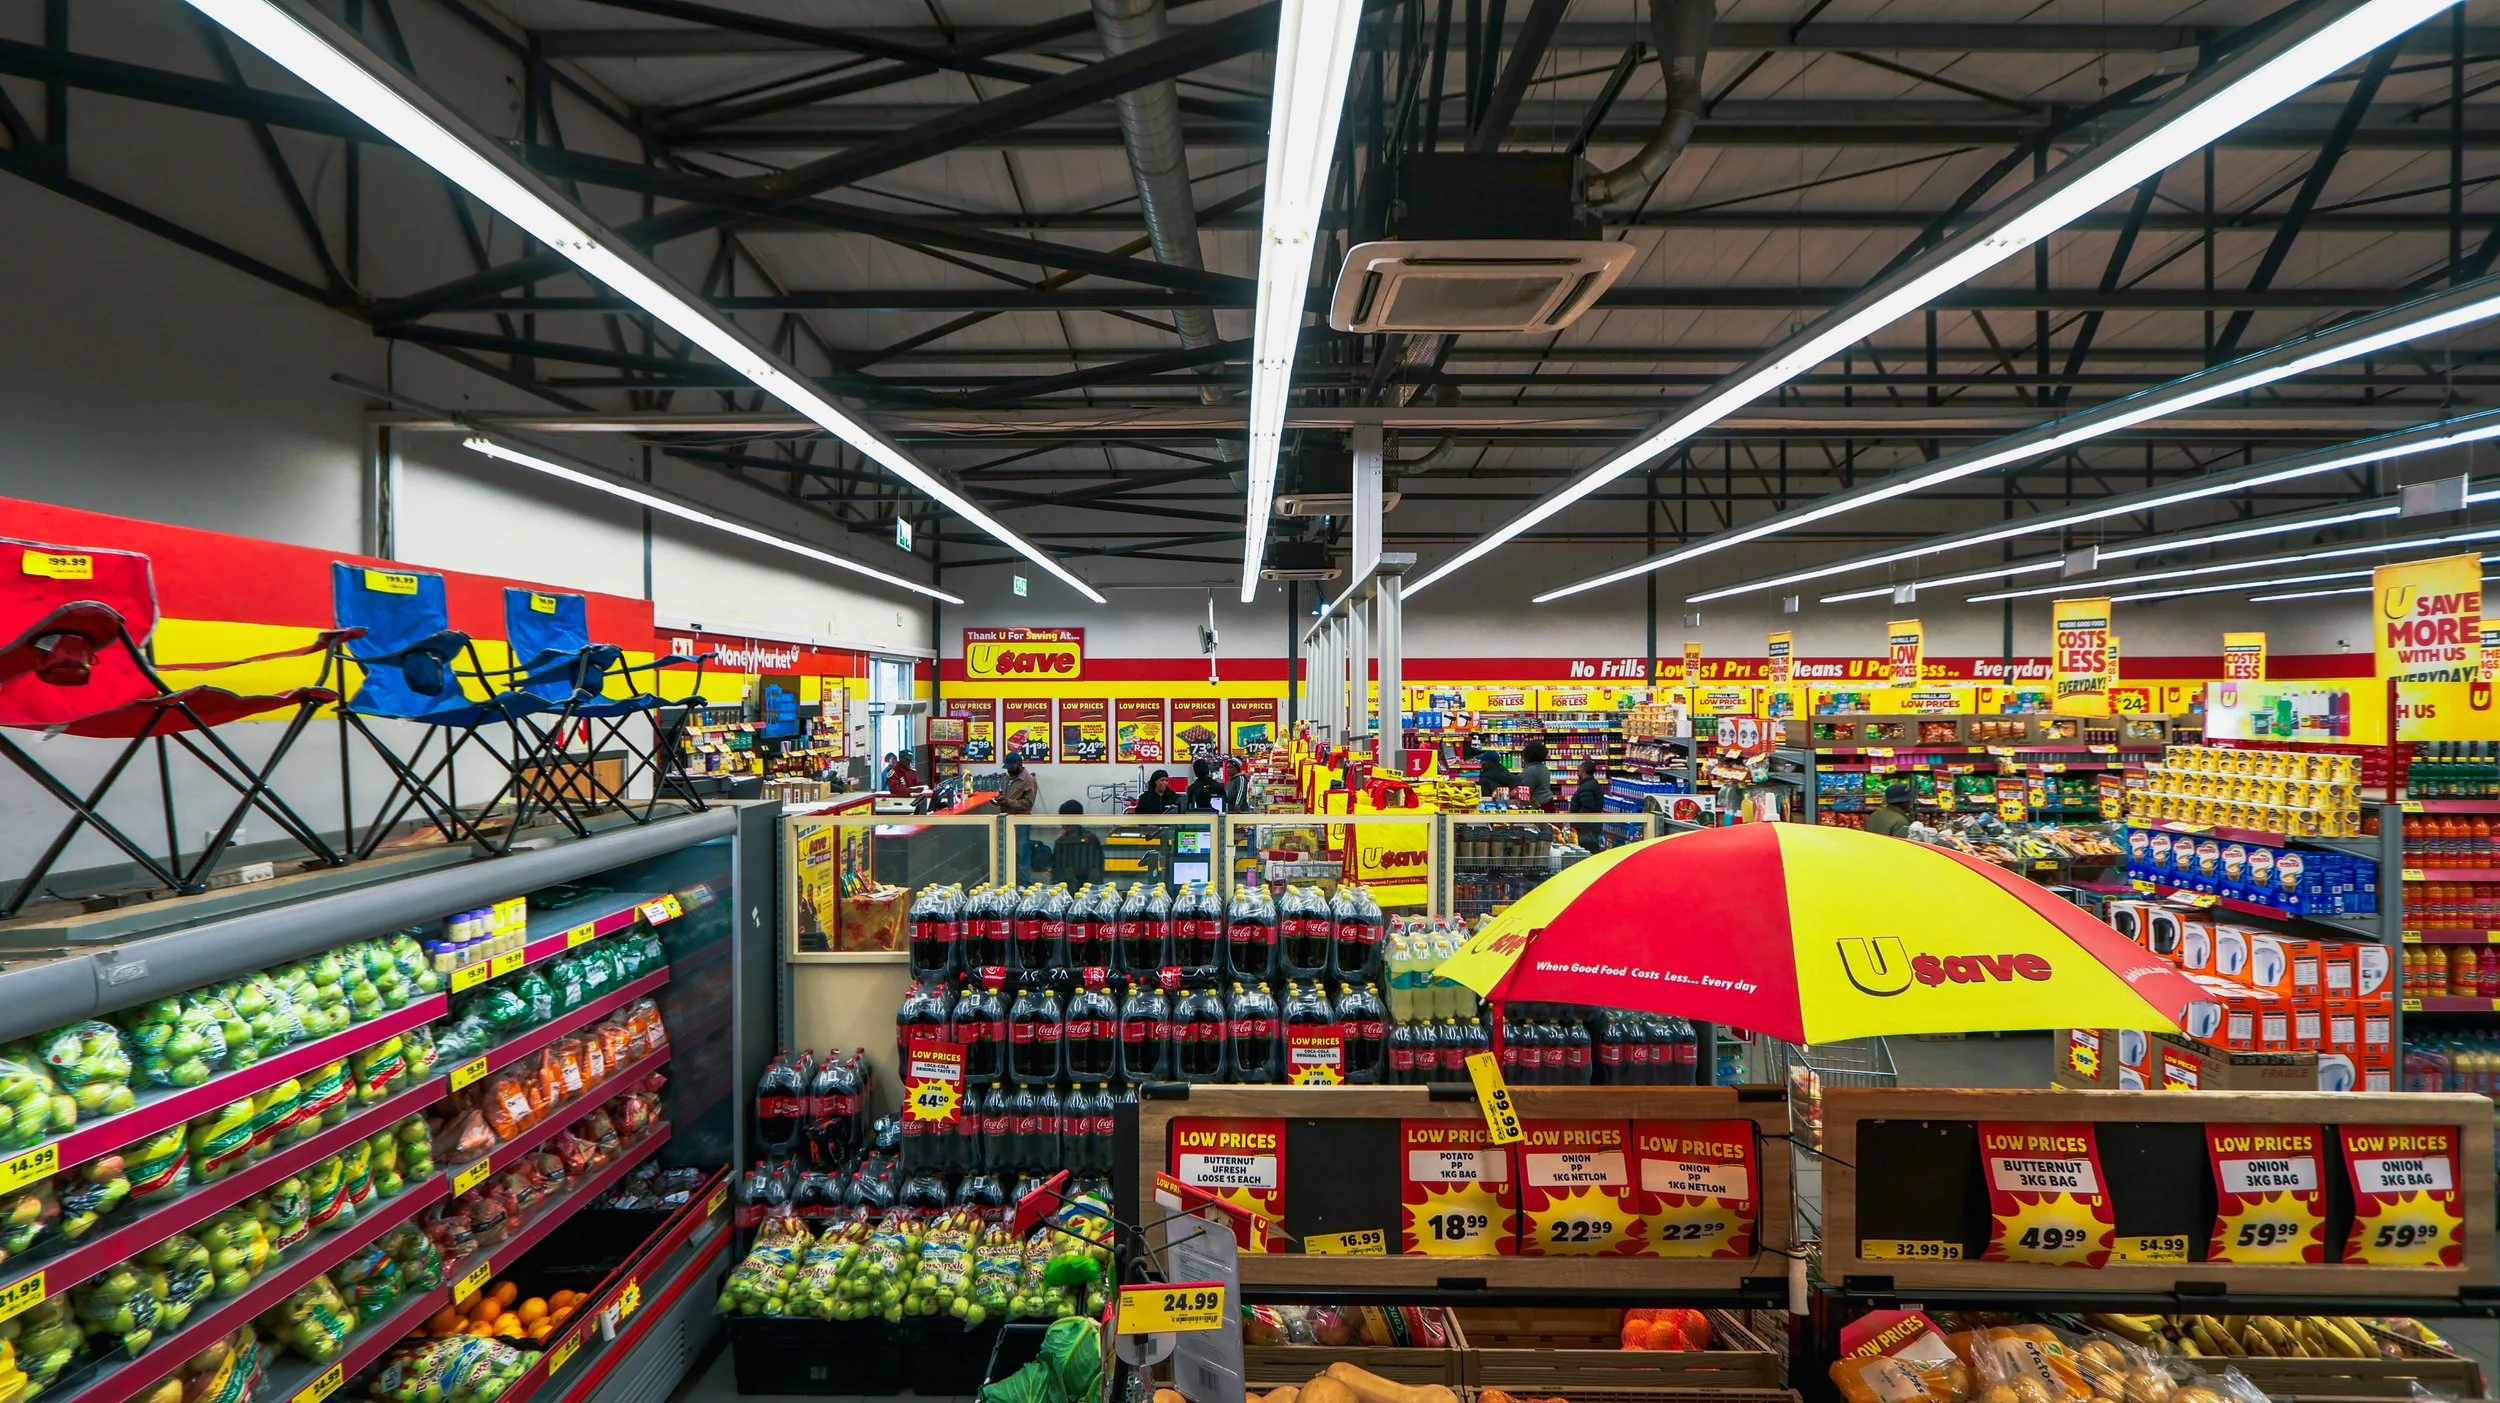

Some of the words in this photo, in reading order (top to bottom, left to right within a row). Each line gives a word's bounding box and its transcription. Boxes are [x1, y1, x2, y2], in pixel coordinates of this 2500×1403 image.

[2384, 584, 2416, 620] U
[2416, 591, 2480, 617] SAVE
[967, 631, 997, 640] Thank
[999, 632, 1006, 640] U
[1008, 632, 1025, 640] For
[1026, 631, 1058, 642] Saving
[1060, 632, 1080, 640] At...
[2387, 615, 2481, 648] MORE
[2058, 630, 2107, 649] COSTS
[1890, 646, 1918, 664] LOW
[2058, 650, 2106, 673] LESS
[2225, 653, 2261, 664] COSTS
[2398, 649, 2440, 664] WITH
[2444, 647, 2466, 661] US
[1570, 660, 1595, 678] No
[1600, 659, 1645, 678] Frills
[1655, 660, 1718, 678] Lowst
[1849, 660, 1862, 677] U
[1890, 665, 1918, 678] PRICES
[2226, 665, 2260, 680] LESS
[2058, 677, 2107, 694] EVERYDAY!
[1119, 702, 1135, 710] LOW
[1136, 702, 1160, 710] PRICES
[1174, 702, 1190, 710] LOW
[1191, 702, 1216, 710] PRICES
[1232, 702, 1247, 710] LOW
[1248, 702, 1273, 710] PRICES
[1506, 698, 1524, 706] LESS
[1569, 698, 1588, 706] LESS
[1901, 700, 1924, 708] LOW
[1926, 700, 1960, 708] PRICES
[2414, 704, 2436, 718] US
[1412, 758, 1422, 770] 1
[1536, 961, 1570, 973] Where
[1571, 963, 1600, 974] Good
[1600, 964, 1627, 977] Food
[1631, 968, 1660, 980] Costs
[1664, 970, 1700, 985] Less...
[1701, 975, 1733, 991] Every
[1734, 980, 1758, 994] day
[1292, 1037, 1310, 1046] LOW
[1311, 1037, 1340, 1046] PRICES
[912, 1050, 931, 1059] LOW
[932, 1052, 962, 1062] PRICES
[2164, 1055, 2177, 1064] LOW
[2178, 1058, 2198, 1072] PRICES
[2262, 1068, 2308, 1078] FRAGILE
[1492, 1089, 1520, 1138] 99.99
[1180, 1132, 1217, 1149] LOW
[1219, 1132, 1277, 1149] PRICES
[1408, 1130, 1445, 1144] LOW
[1524, 1132, 1561, 1146] LOW
[1564, 1130, 1622, 1146] PRICES
[1986, 1134, 2024, 1151] LOW
[2028, 1136, 2087, 1153] PRICES
[1640, 1136, 1678, 1153] LOW
[1682, 1140, 1744, 1160] PRICES
[2214, 1137, 2250, 1153] LOW
[2255, 1136, 2313, 1151] PRICES
[2348, 1137, 2384, 1152] LOW
[2389, 1136, 2447, 1150] PRICES
[8, 1149, 54, 1176] 14.99
[1203, 1156, 1256, 1166] BUTTERNUT
[1439, 1152, 1474, 1162] POTATO
[1562, 1154, 1591, 1164] ONION
[1212, 1166, 1247, 1174] UFRESH
[1679, 1163, 1710, 1174] ONION
[2003, 1160, 2082, 1174] BUTTERNUT
[2248, 1160, 2290, 1172] ONION
[2382, 1160, 2423, 1172] ONION
[1197, 1174, 1225, 1184] LOOSE
[1237, 1175, 1262, 1184] EACH
[1440, 1170, 1457, 1179] 1KG
[1459, 1170, 1478, 1178] BAG
[1552, 1172, 1569, 1182] 1KG
[1570, 1172, 1608, 1182] NETLON
[1688, 1172, 1700, 1181] PP
[2020, 1174, 2047, 1186] 3KG
[2050, 1174, 2078, 1188] BAG
[2246, 1175, 2272, 1187] 3KG
[2274, 1174, 2300, 1186] BAG
[2382, 1174, 2406, 1186] 3KG
[2408, 1174, 2433, 1186] BAG
[1156, 1177, 1170, 1190] LOW
[1498, 1183, 1509, 1195] U
[1668, 1180, 1686, 1192] 1KG
[1687, 1182, 1726, 1194] NETLON
[1266, 1190, 1278, 1202] U
[1620, 1186, 1630, 1199] U
[2310, 1191, 2318, 1202] U
[2446, 1191, 2454, 1202] U
[2091, 1195, 2102, 1207] U
[1339, 1232, 1382, 1248] 16.99
[2140, 1238, 2184, 1250] 54.99
[1897, 1242, 1940, 1256] 32.99
[1163, 1292, 1218, 1312] 24.99
[1883, 1315, 1924, 1348] PRICES
